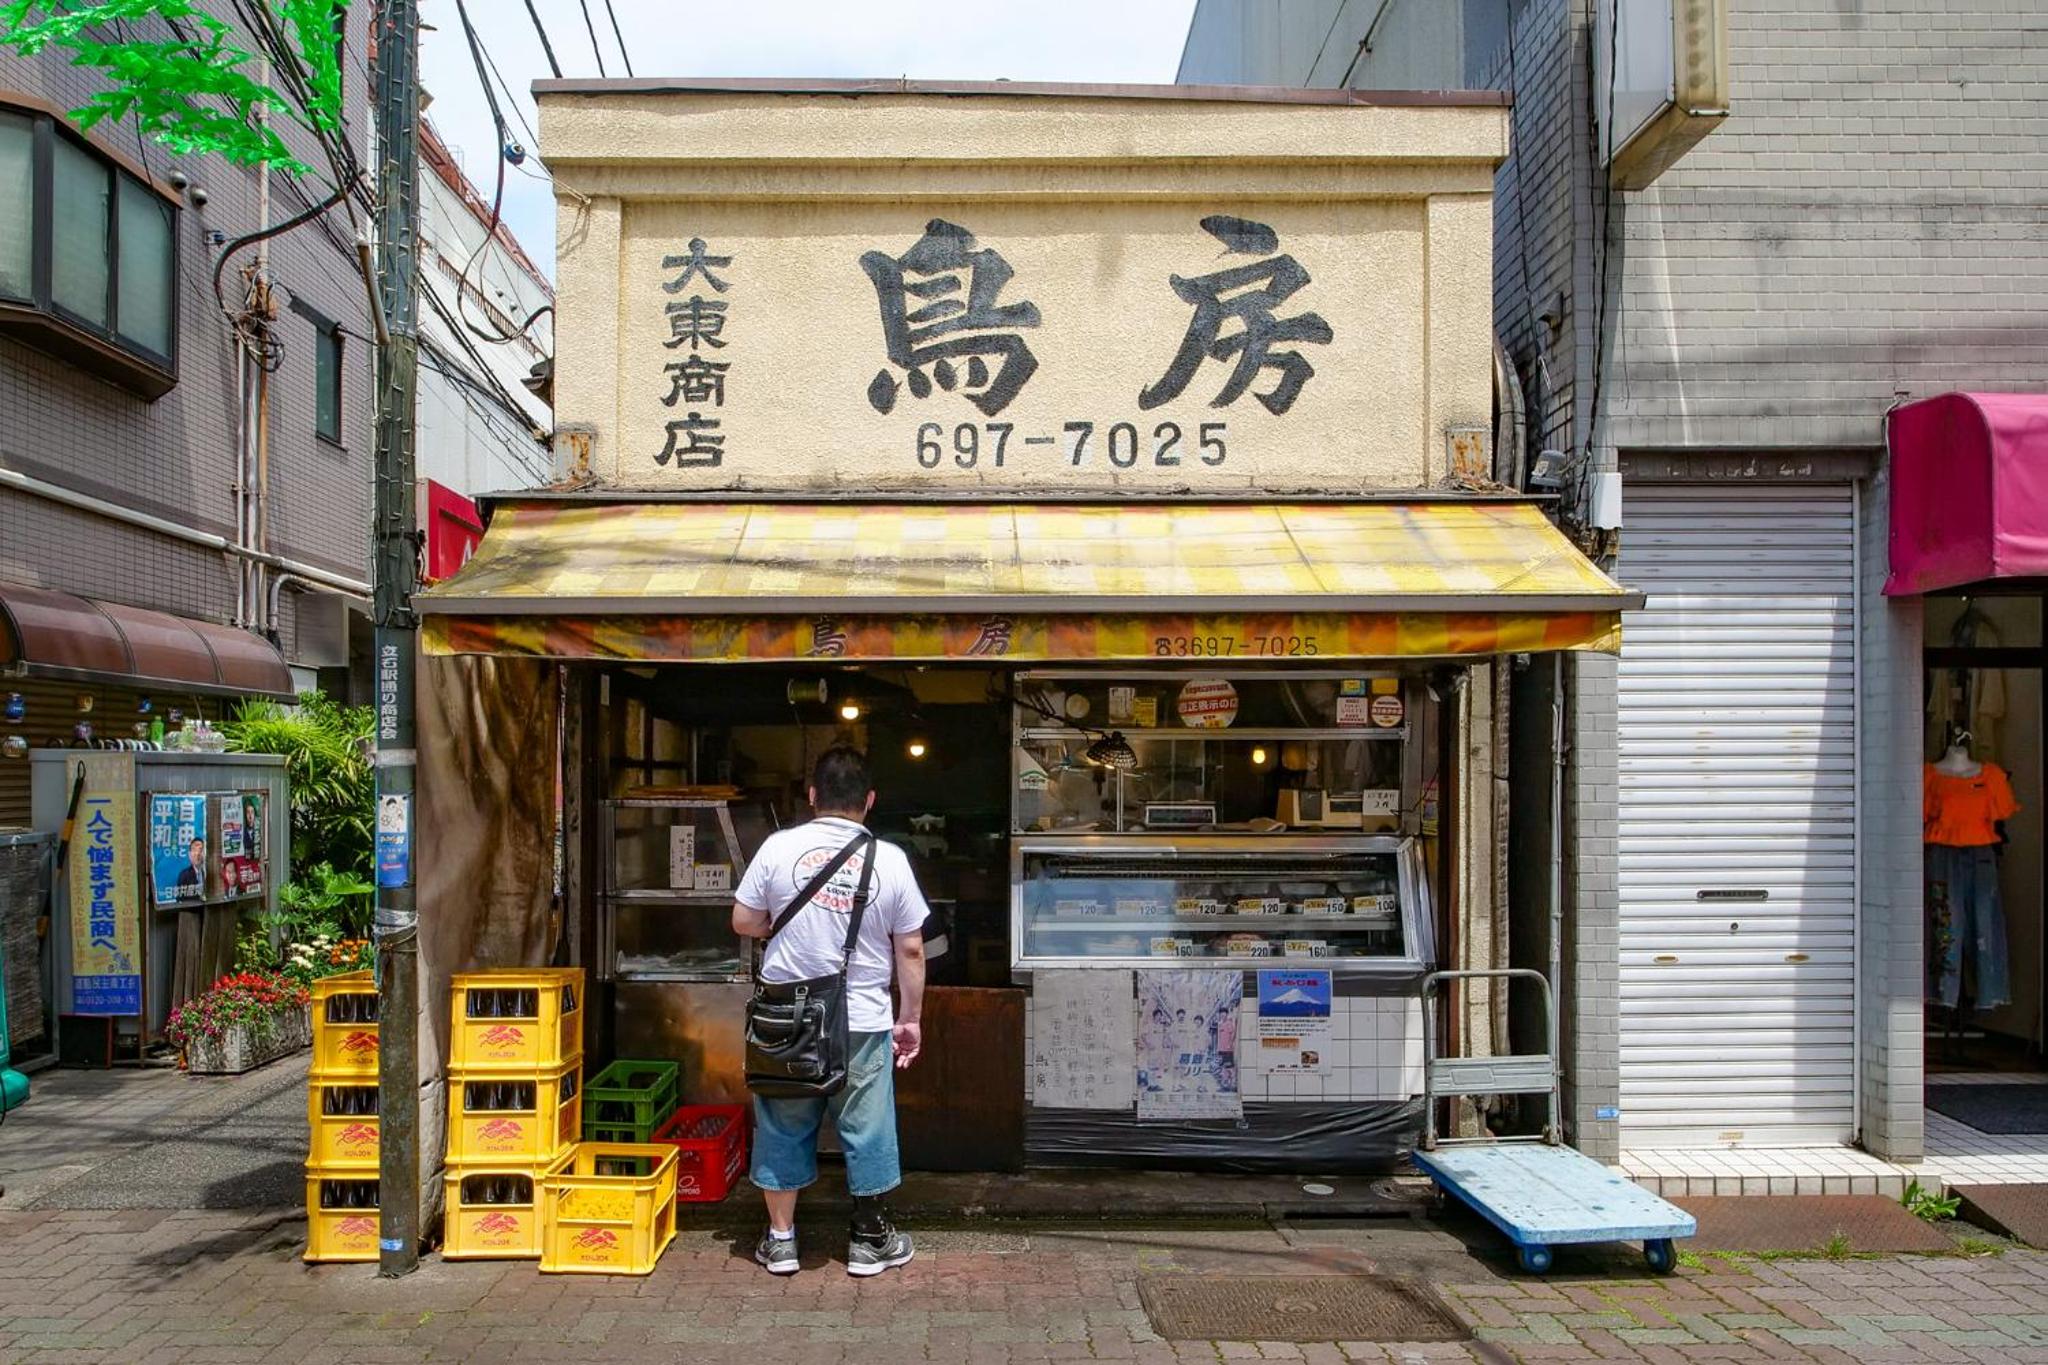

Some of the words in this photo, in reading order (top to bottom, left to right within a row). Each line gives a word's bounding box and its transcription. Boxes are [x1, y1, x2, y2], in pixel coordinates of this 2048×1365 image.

[858, 214, 1335, 417] 鳥房
[653, 237, 733, 470] 大東商店
[916, 421, 1228, 470] 697-7025
[86, 798, 117, 952] 一人で悩まず民商へ
[1199, 903, 1217, 915] 120
[1261, 903, 1279, 914] 120
[1326, 902, 1344, 913] 150
[1377, 900, 1395, 912] 100
[1250, 947, 1269, 958] 220
